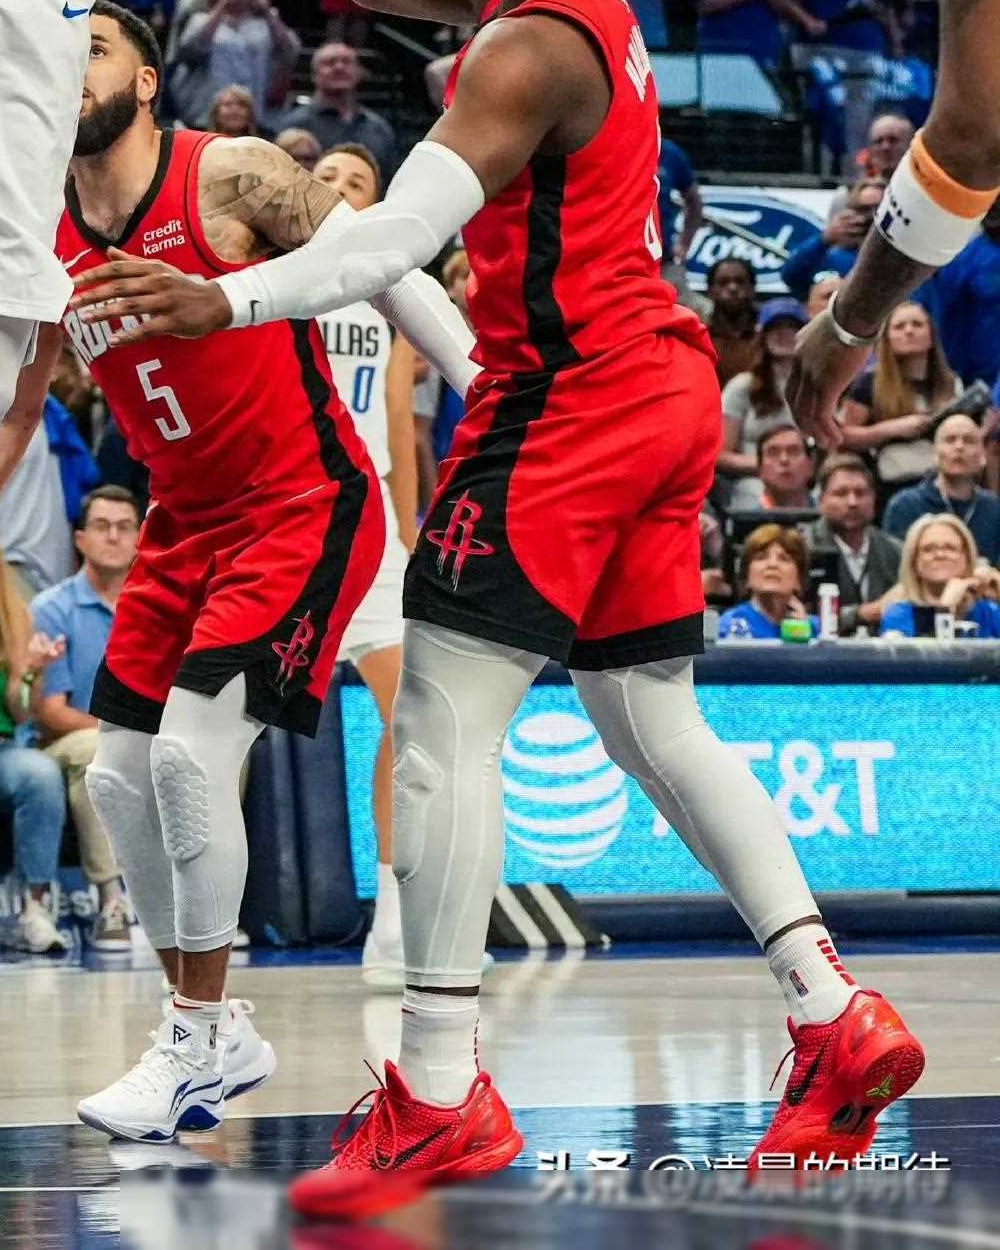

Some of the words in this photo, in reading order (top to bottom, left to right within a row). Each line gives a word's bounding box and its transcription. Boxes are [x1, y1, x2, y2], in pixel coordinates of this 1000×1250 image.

[142, 234, 186, 256] karma
[143, 219, 183, 242] credit
[676, 204, 794, 270] Ford
[135, 358, 192, 441] 5
[352, 365, 376, 414] 0
[653, 739, 895, 837] T&T
